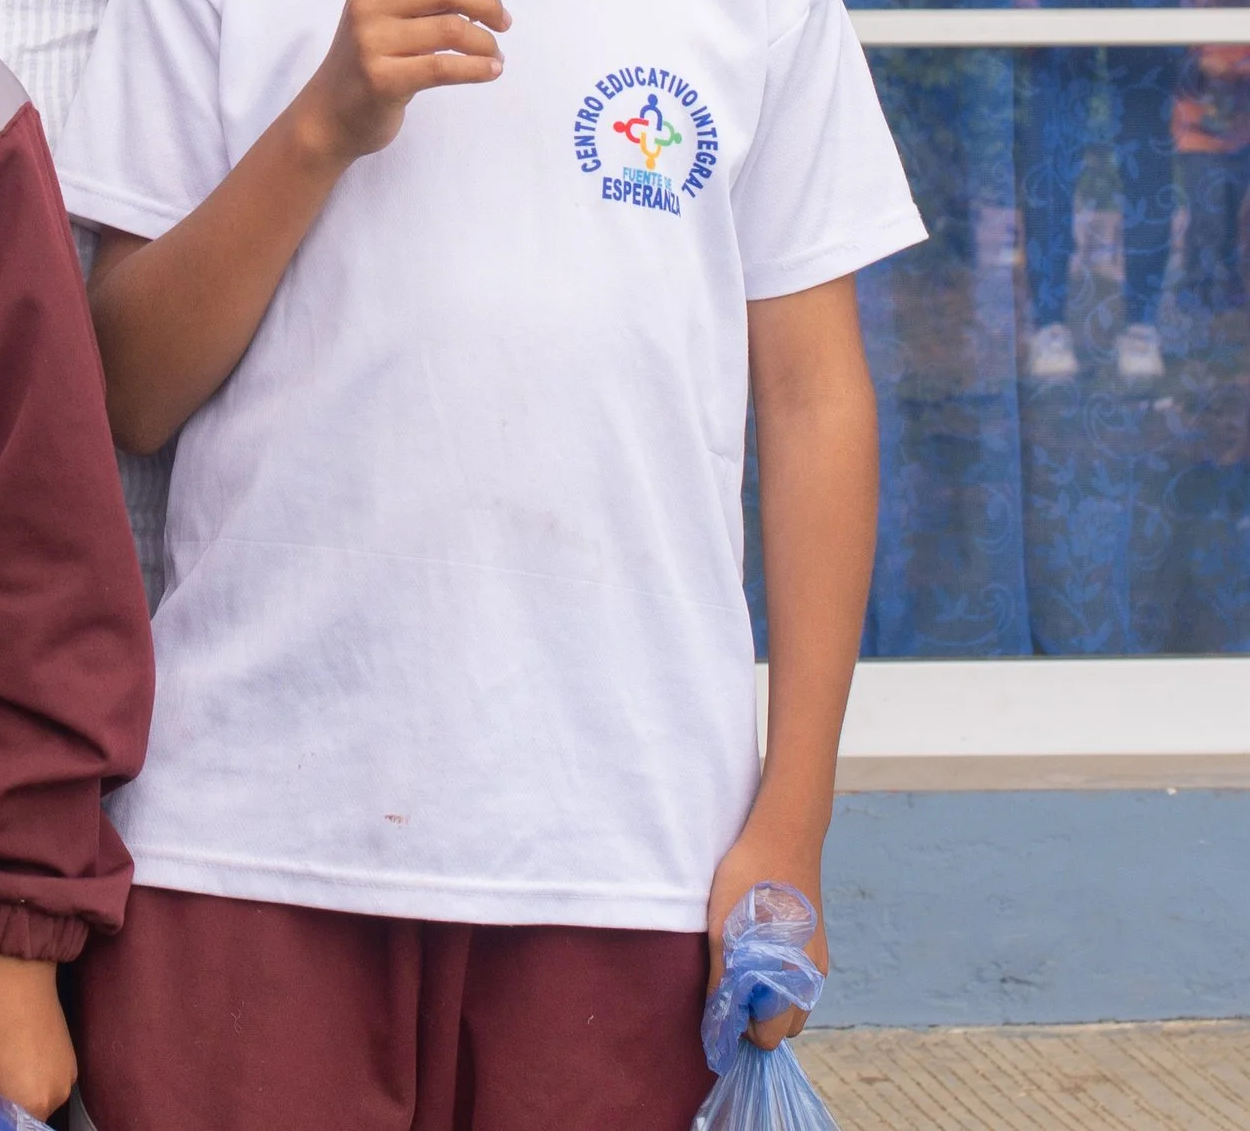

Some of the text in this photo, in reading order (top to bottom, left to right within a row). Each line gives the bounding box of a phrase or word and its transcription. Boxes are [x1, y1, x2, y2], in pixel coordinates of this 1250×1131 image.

[574, 66, 719, 198] CENTRO EDUCATIVO INTEGRAL
[602, 176, 681, 218] ESPERANZA
[623, 166, 663, 188] FUENTE
